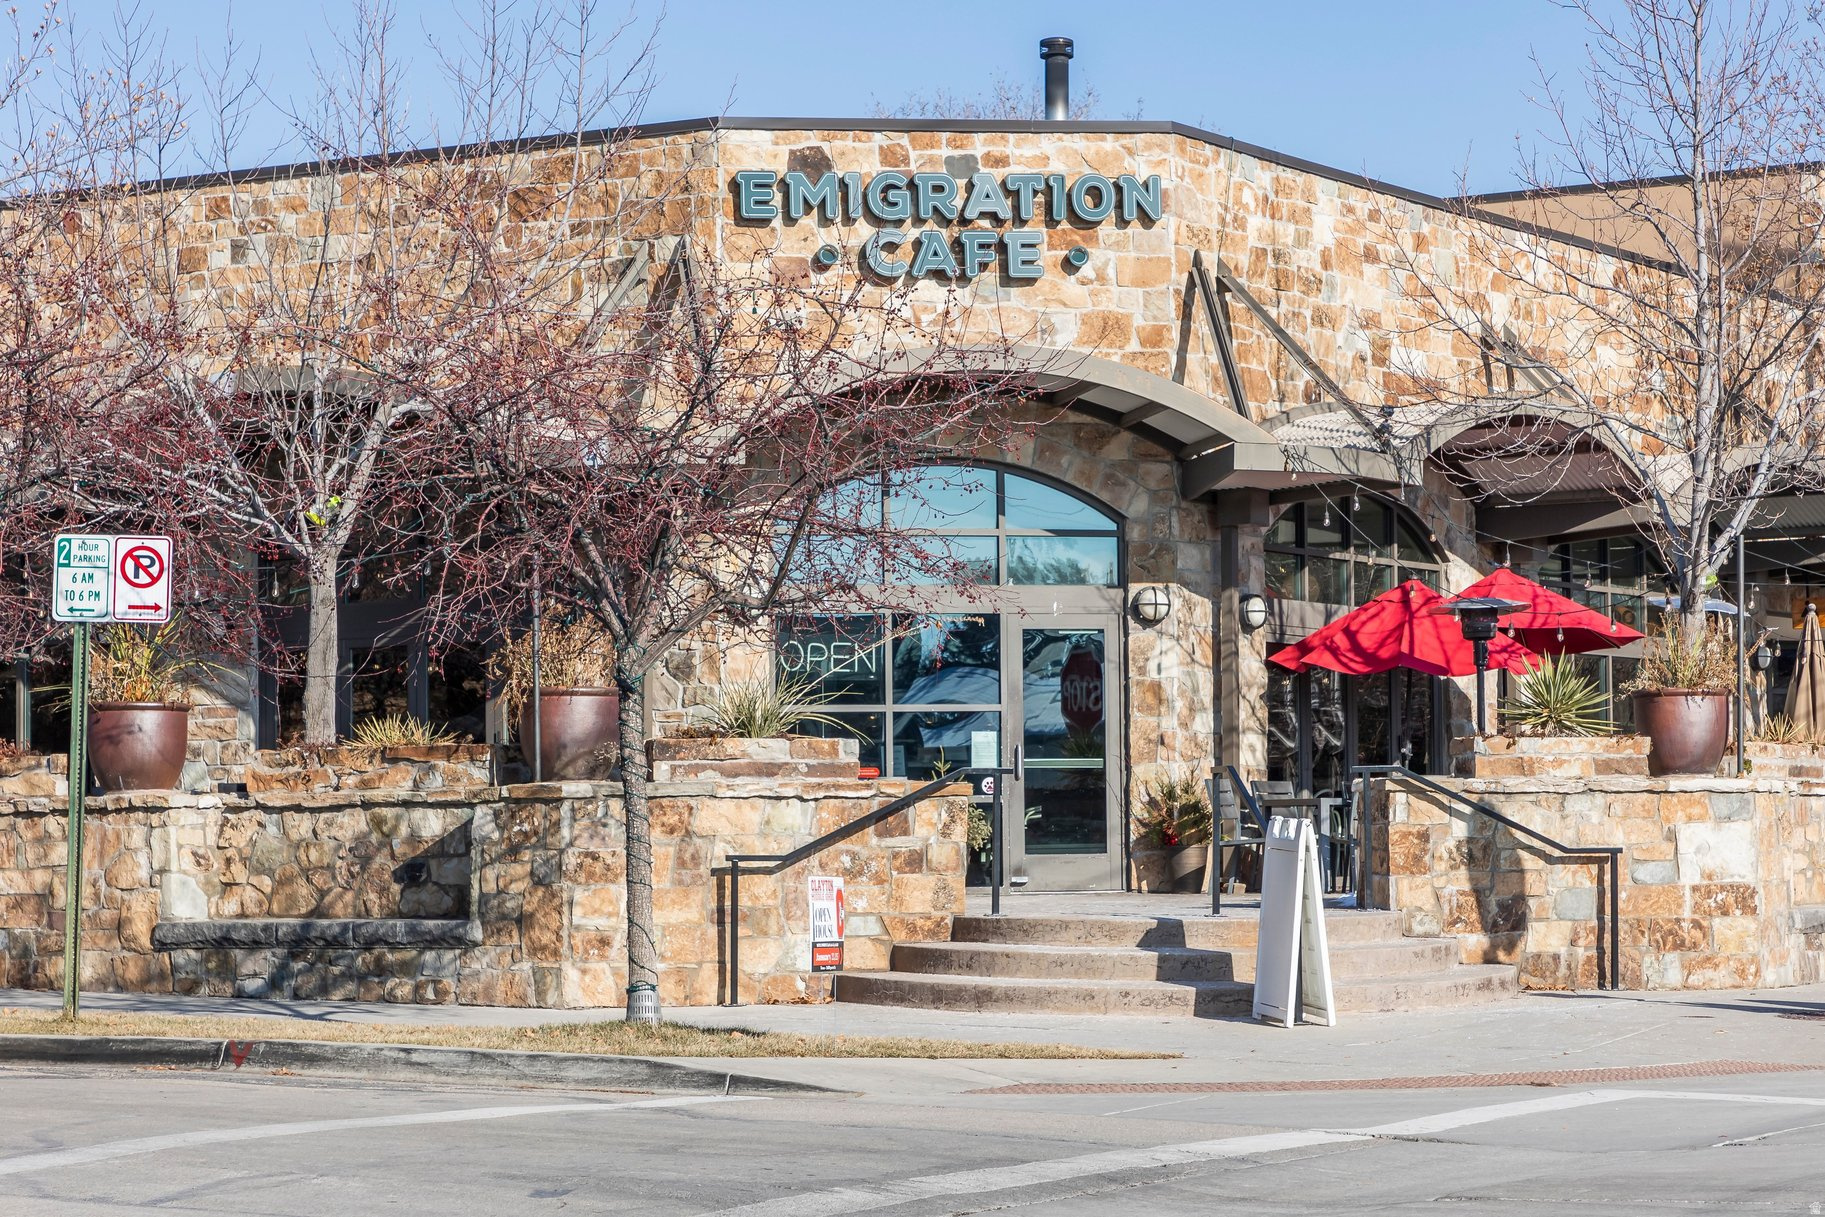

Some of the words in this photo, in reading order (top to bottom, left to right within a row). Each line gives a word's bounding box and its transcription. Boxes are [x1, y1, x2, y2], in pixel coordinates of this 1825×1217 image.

[735, 170, 1163, 222] EMIGRATION
[865, 229, 1045, 279] CAFE
[59, 541, 70, 564] 2
[78, 543, 99, 552] HOUR
[73, 554, 106, 563] PARKING
[71, 572, 78, 584] 6
[81, 572, 94, 584] AM
[64, 590, 75, 602] TO
[78, 590, 84, 602] 6
[88, 590, 100, 602] PM
[780, 640, 876, 673] OPEN
[815, 907, 831, 922] OPEN
[815, 924, 833, 938] HOUSE
